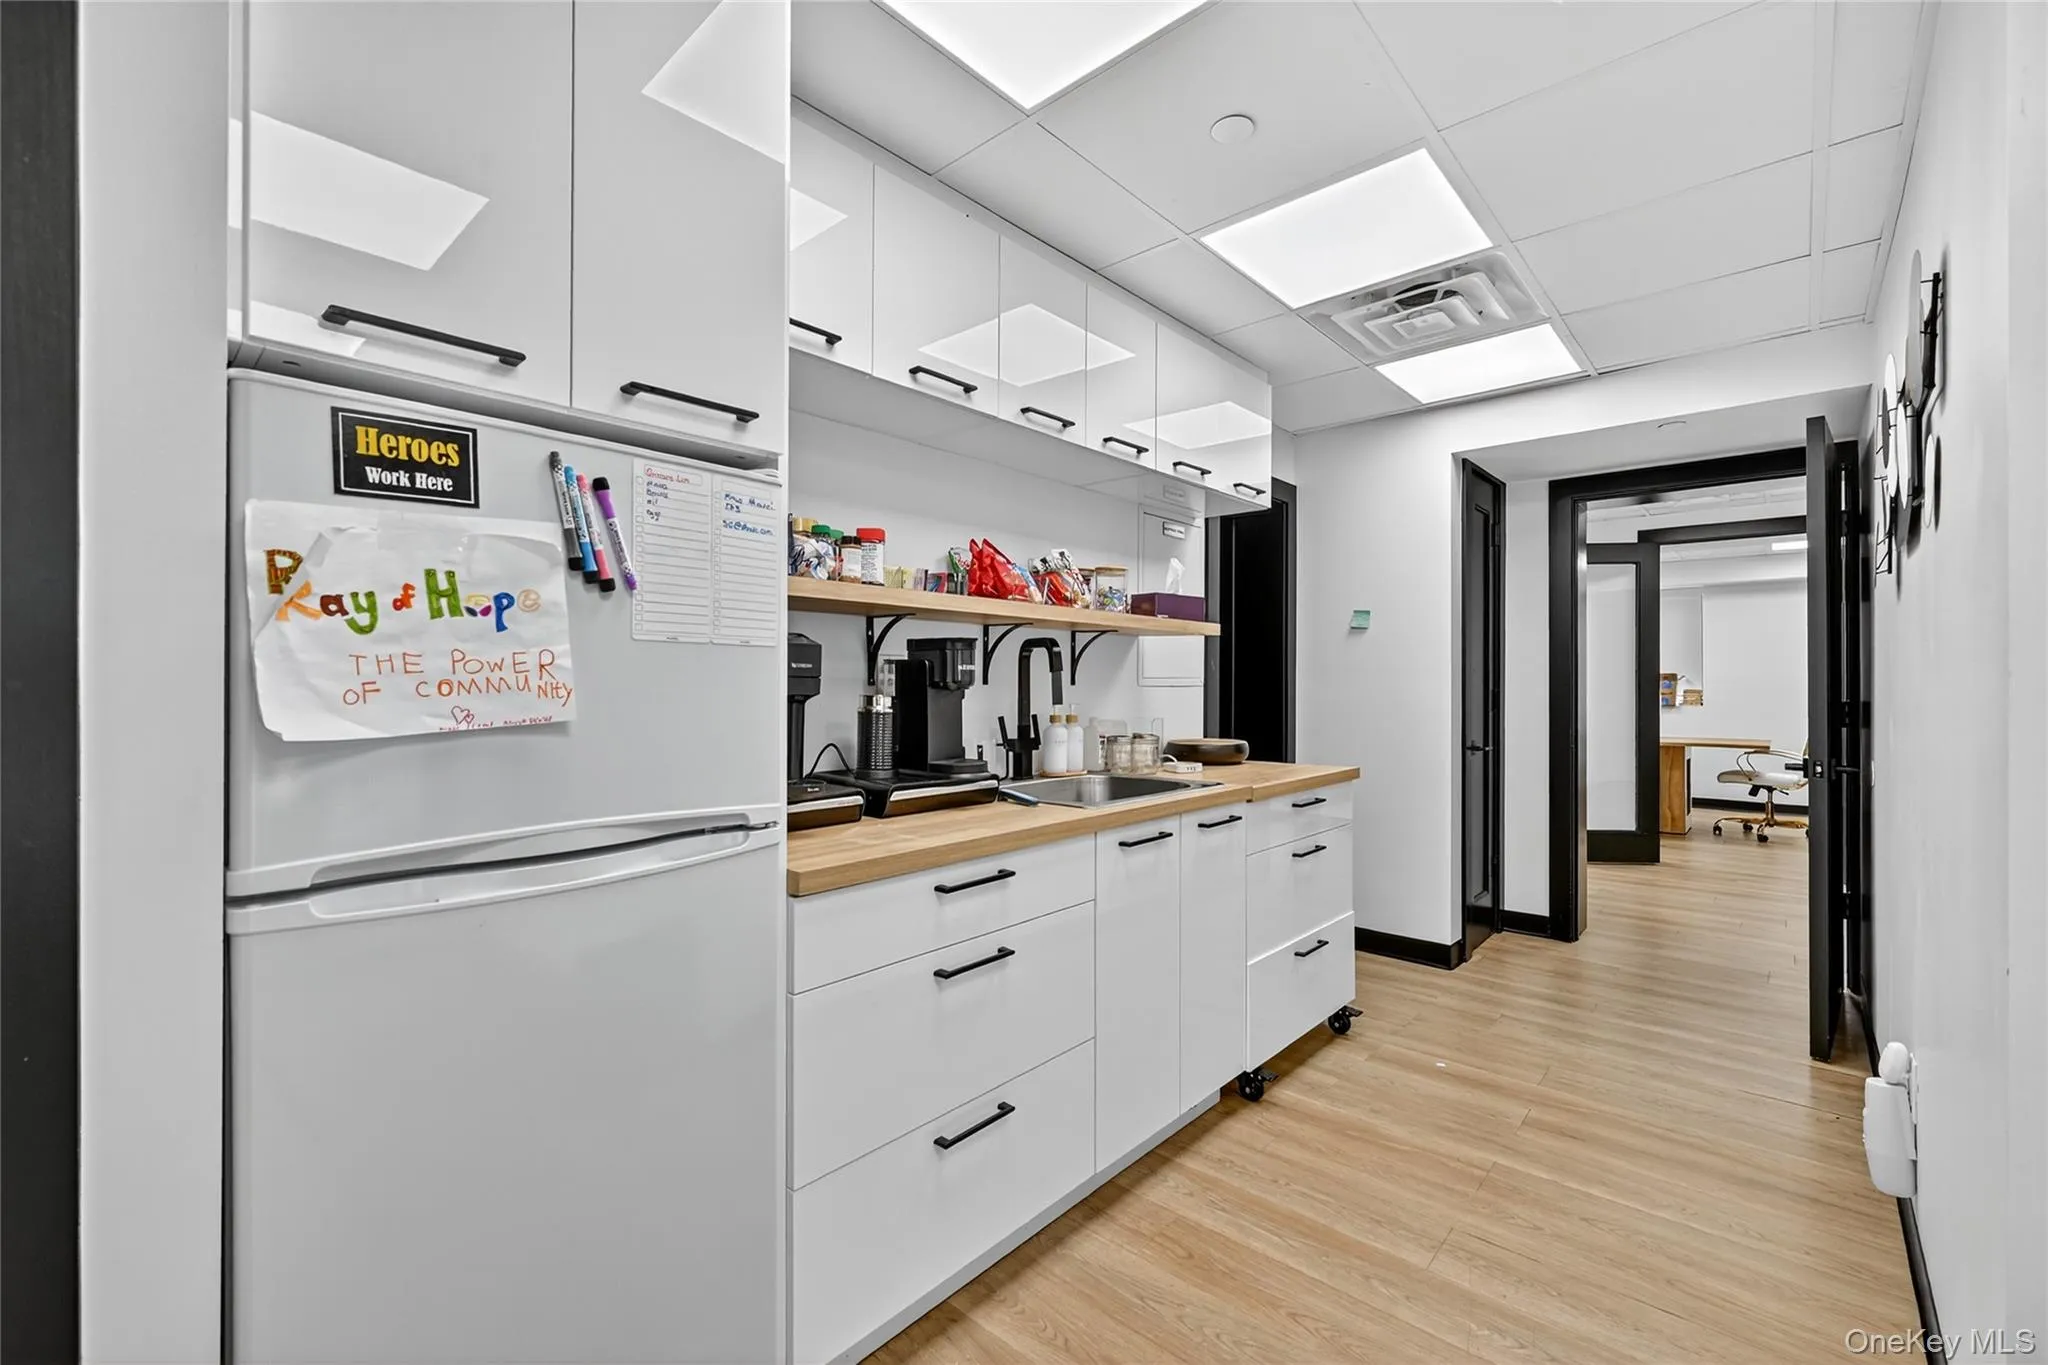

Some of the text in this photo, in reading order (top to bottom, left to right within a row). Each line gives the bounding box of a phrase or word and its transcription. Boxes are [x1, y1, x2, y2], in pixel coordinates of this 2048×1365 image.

[355, 425, 460, 467] Heroes
[365, 466, 453, 492] Work Here
[392, 583, 416, 611] of
[425, 568, 542, 632] Hope
[349, 648, 556, 680] THE POWER
